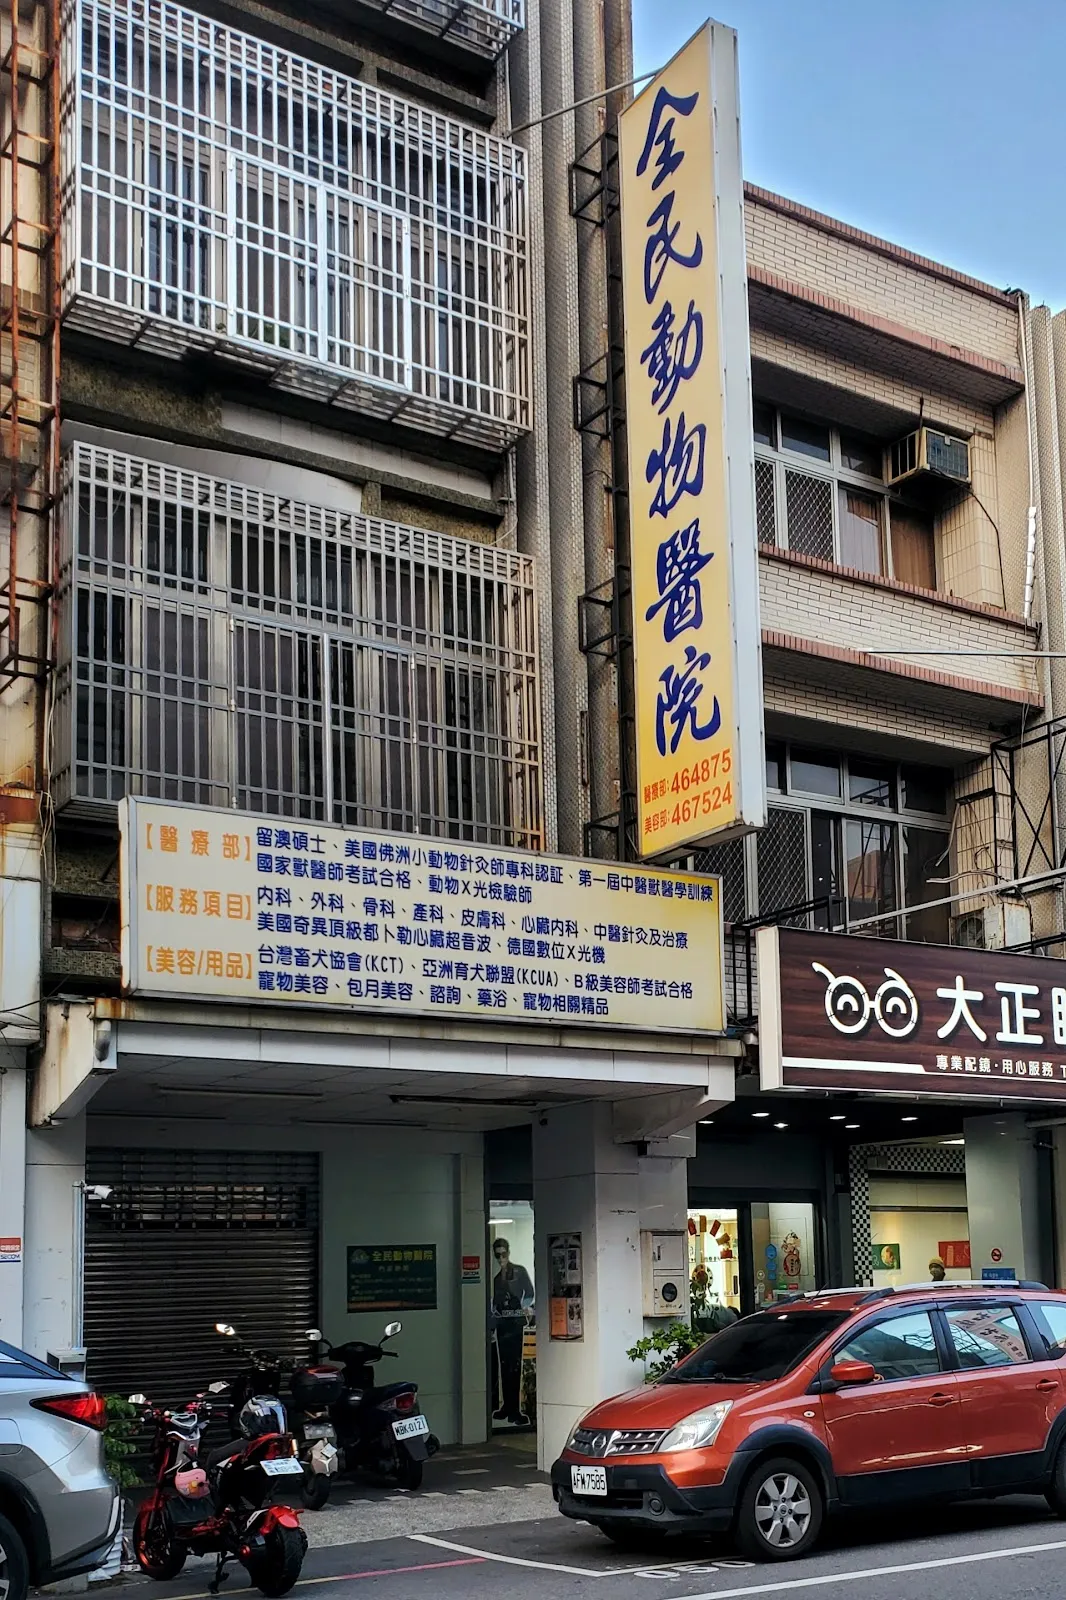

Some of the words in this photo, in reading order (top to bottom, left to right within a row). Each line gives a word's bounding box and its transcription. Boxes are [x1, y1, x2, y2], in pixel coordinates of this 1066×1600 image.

[637, 86, 721, 757] 全民動物醫院
[936, 975, 1066, 1046] 大正
